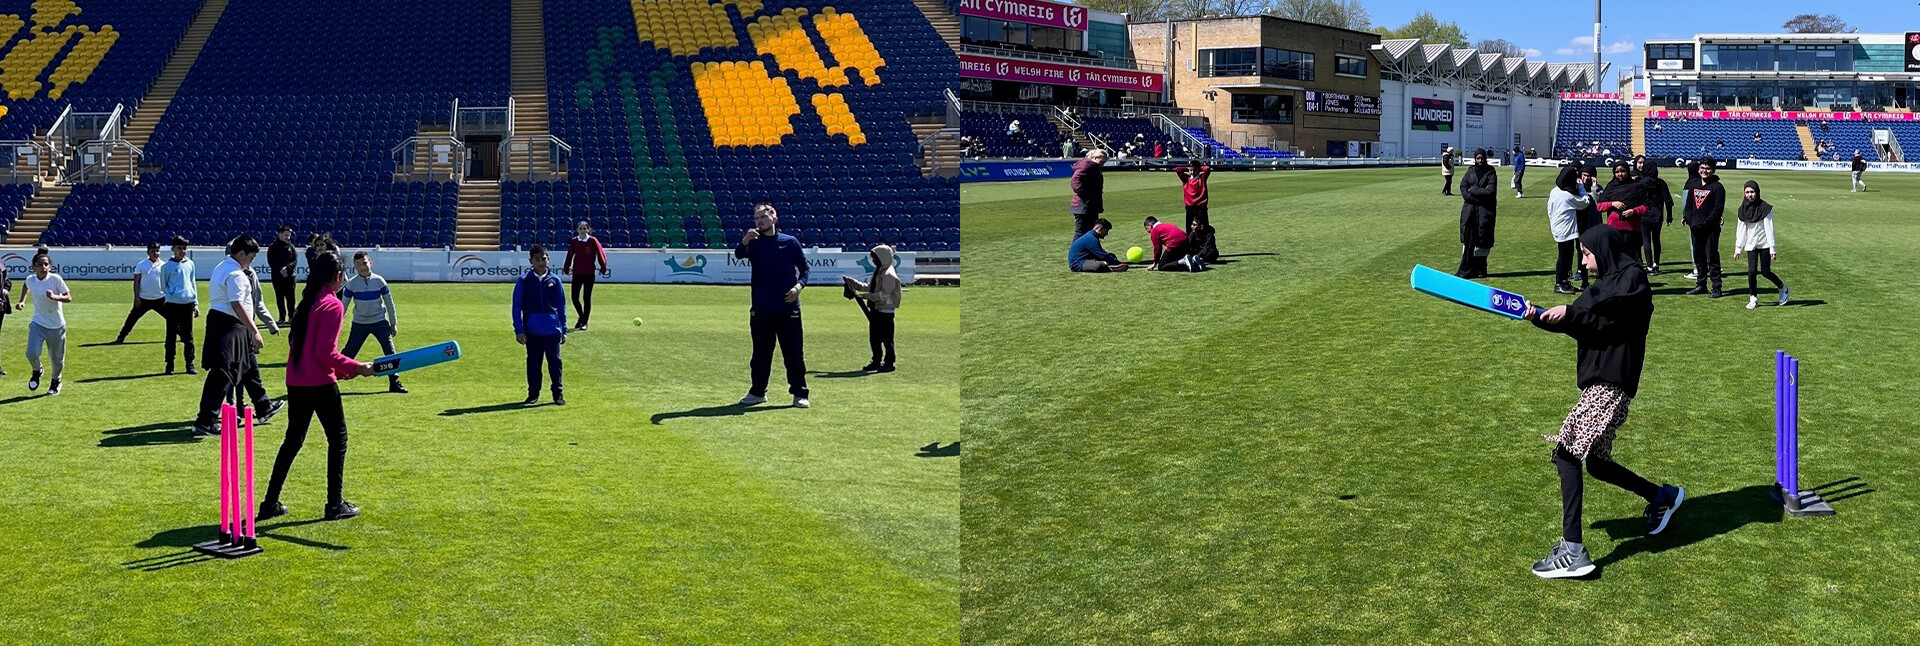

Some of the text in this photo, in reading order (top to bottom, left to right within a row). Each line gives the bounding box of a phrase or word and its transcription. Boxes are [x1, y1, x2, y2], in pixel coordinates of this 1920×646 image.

[1014, 66, 1041, 77] WELSH
[1044, 69, 1064, 79] FIRE
[1102, 74, 1138, 85] CYMREIG
[1414, 107, 1453, 122] HUNDRED
[461, 265, 486, 278] pro
[487, 265, 522, 276] steel
